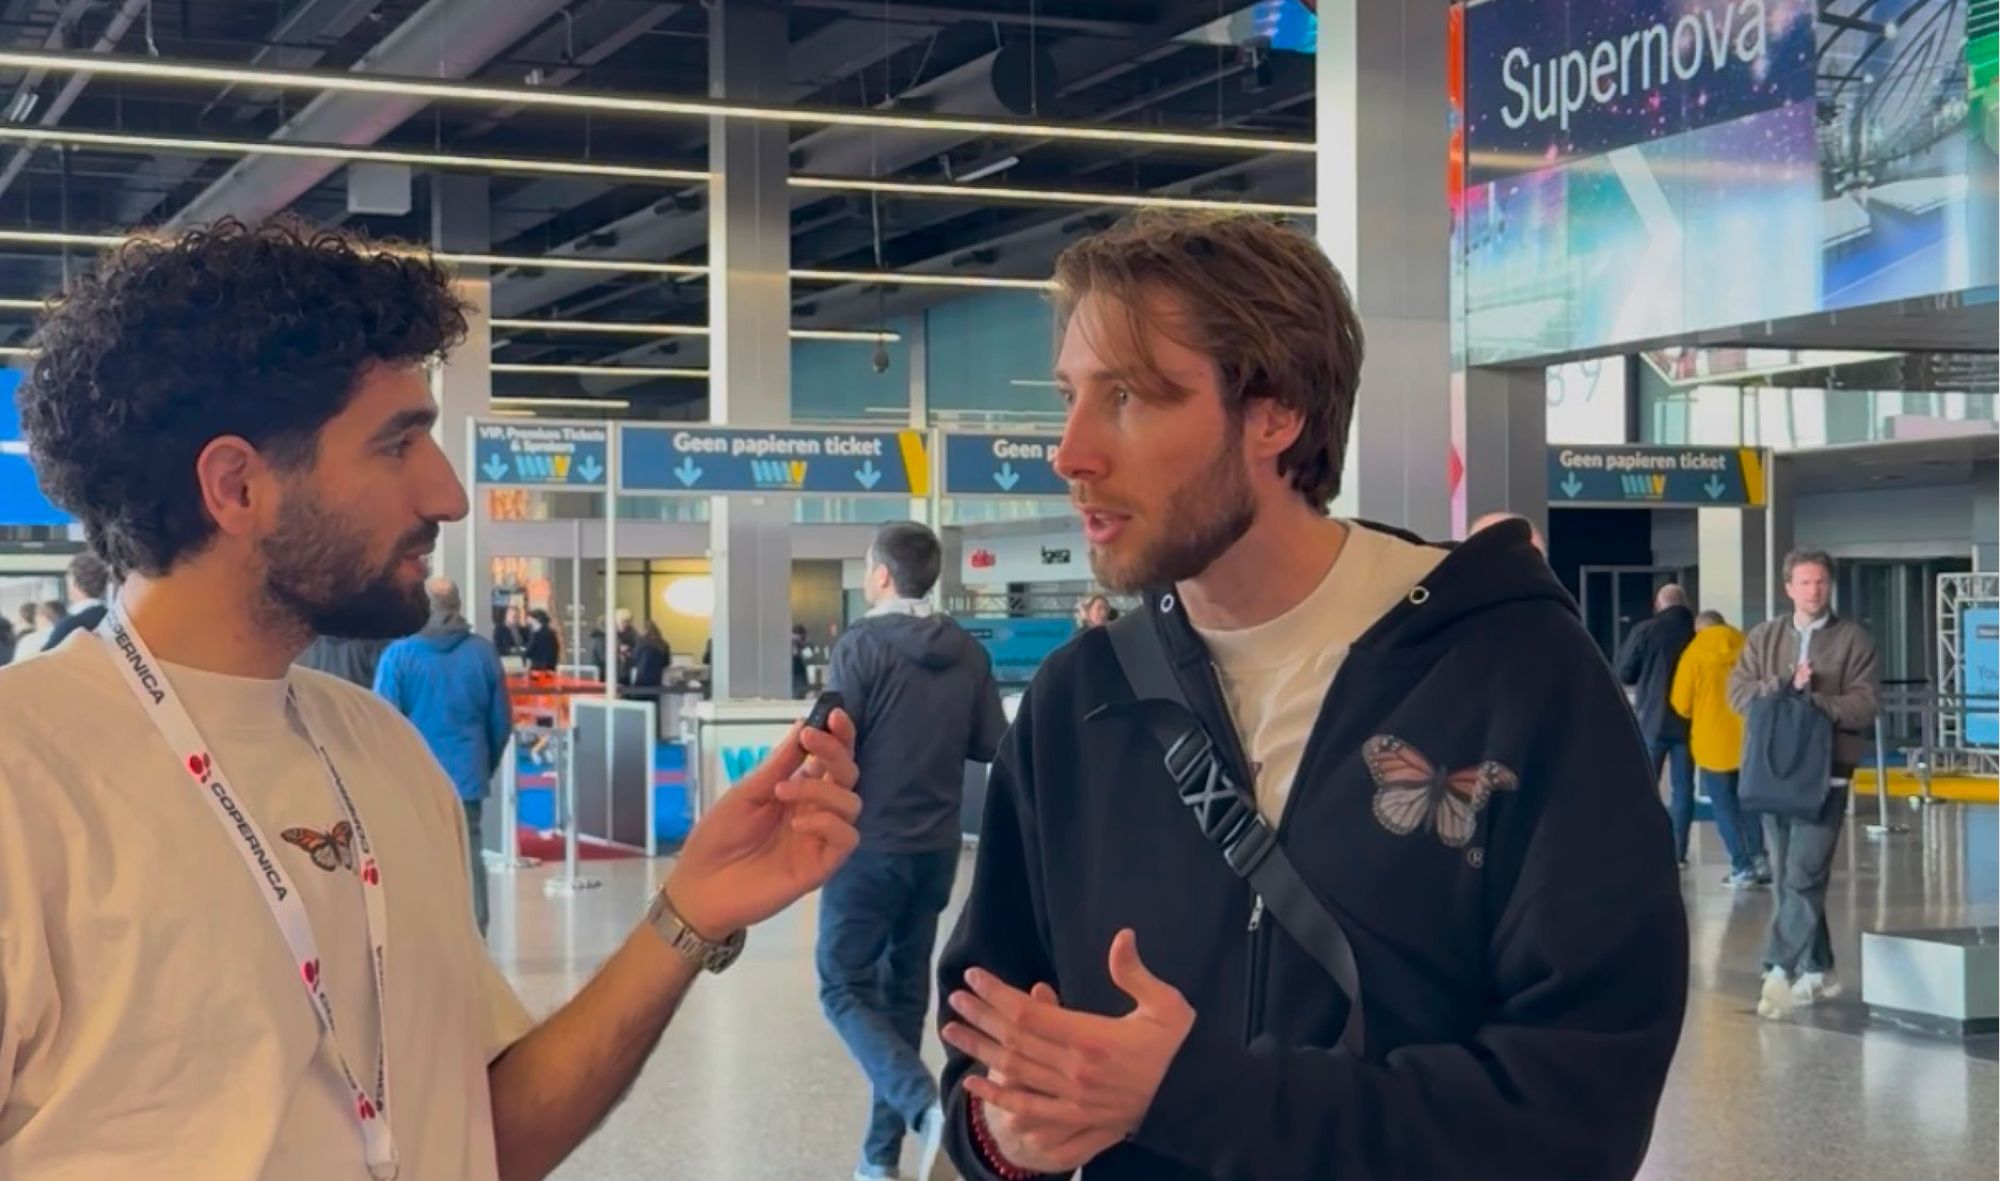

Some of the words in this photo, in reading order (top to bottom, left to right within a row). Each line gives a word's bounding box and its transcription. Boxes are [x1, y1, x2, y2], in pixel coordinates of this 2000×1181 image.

[1500, 0, 1768, 130] Supernova
[672, 432, 728, 453] Geen
[731, 435, 821, 457] papieren
[824, 437, 882, 456] ticket
[992, 439, 1043, 459] Geen
[1559, 450, 1603, 469] Geen
[1605, 452, 1677, 471] papieren
[1679, 453, 1727, 470] ticket
[210, 780, 288, 902] COPERNICA
